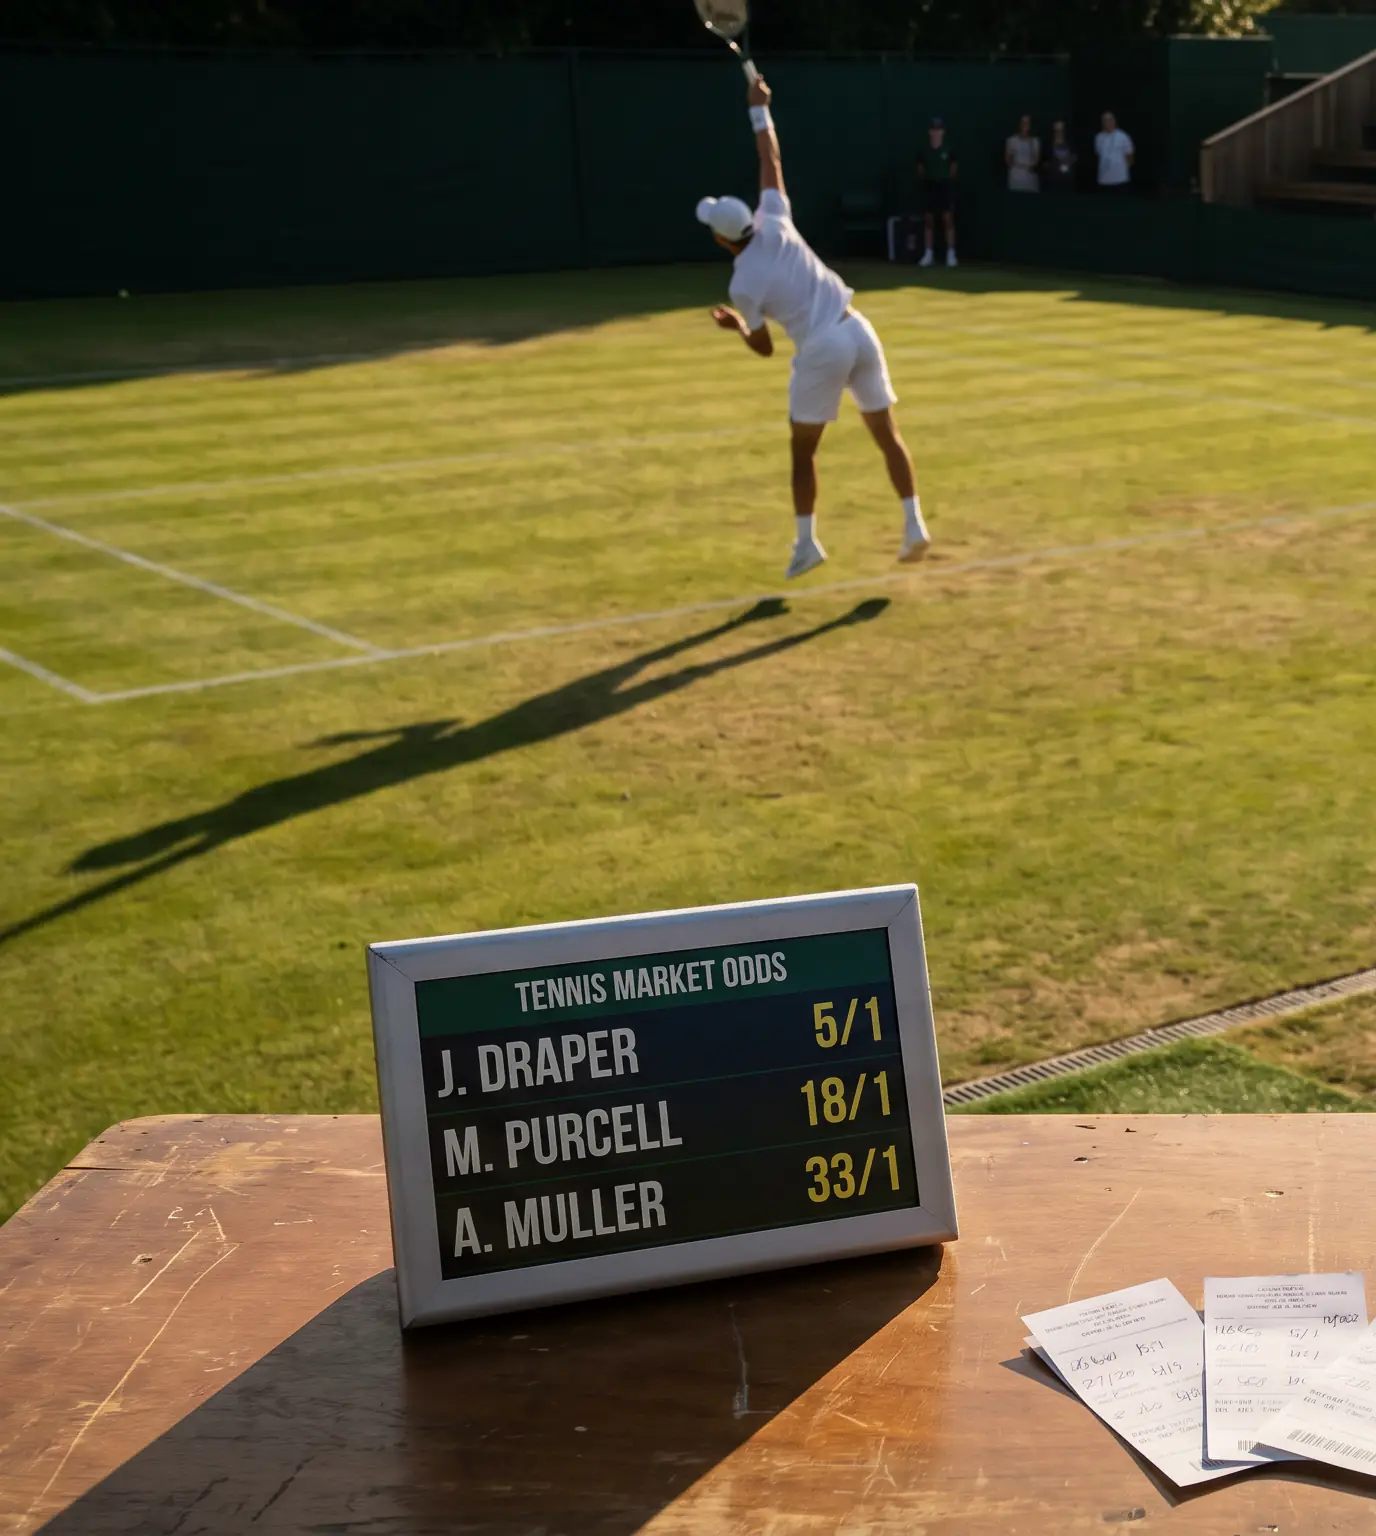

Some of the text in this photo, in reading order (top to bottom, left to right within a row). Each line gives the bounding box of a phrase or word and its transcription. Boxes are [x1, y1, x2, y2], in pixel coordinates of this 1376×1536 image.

[515, 952, 786, 1012] TENNIS MARKET ODDS
[438, 997, 881, 1097] J. DRAPER 5/1
[444, 1071, 890, 1176] M. PURCELL 18/1
[455, 1145, 899, 1257] A. MULLER 33/1
